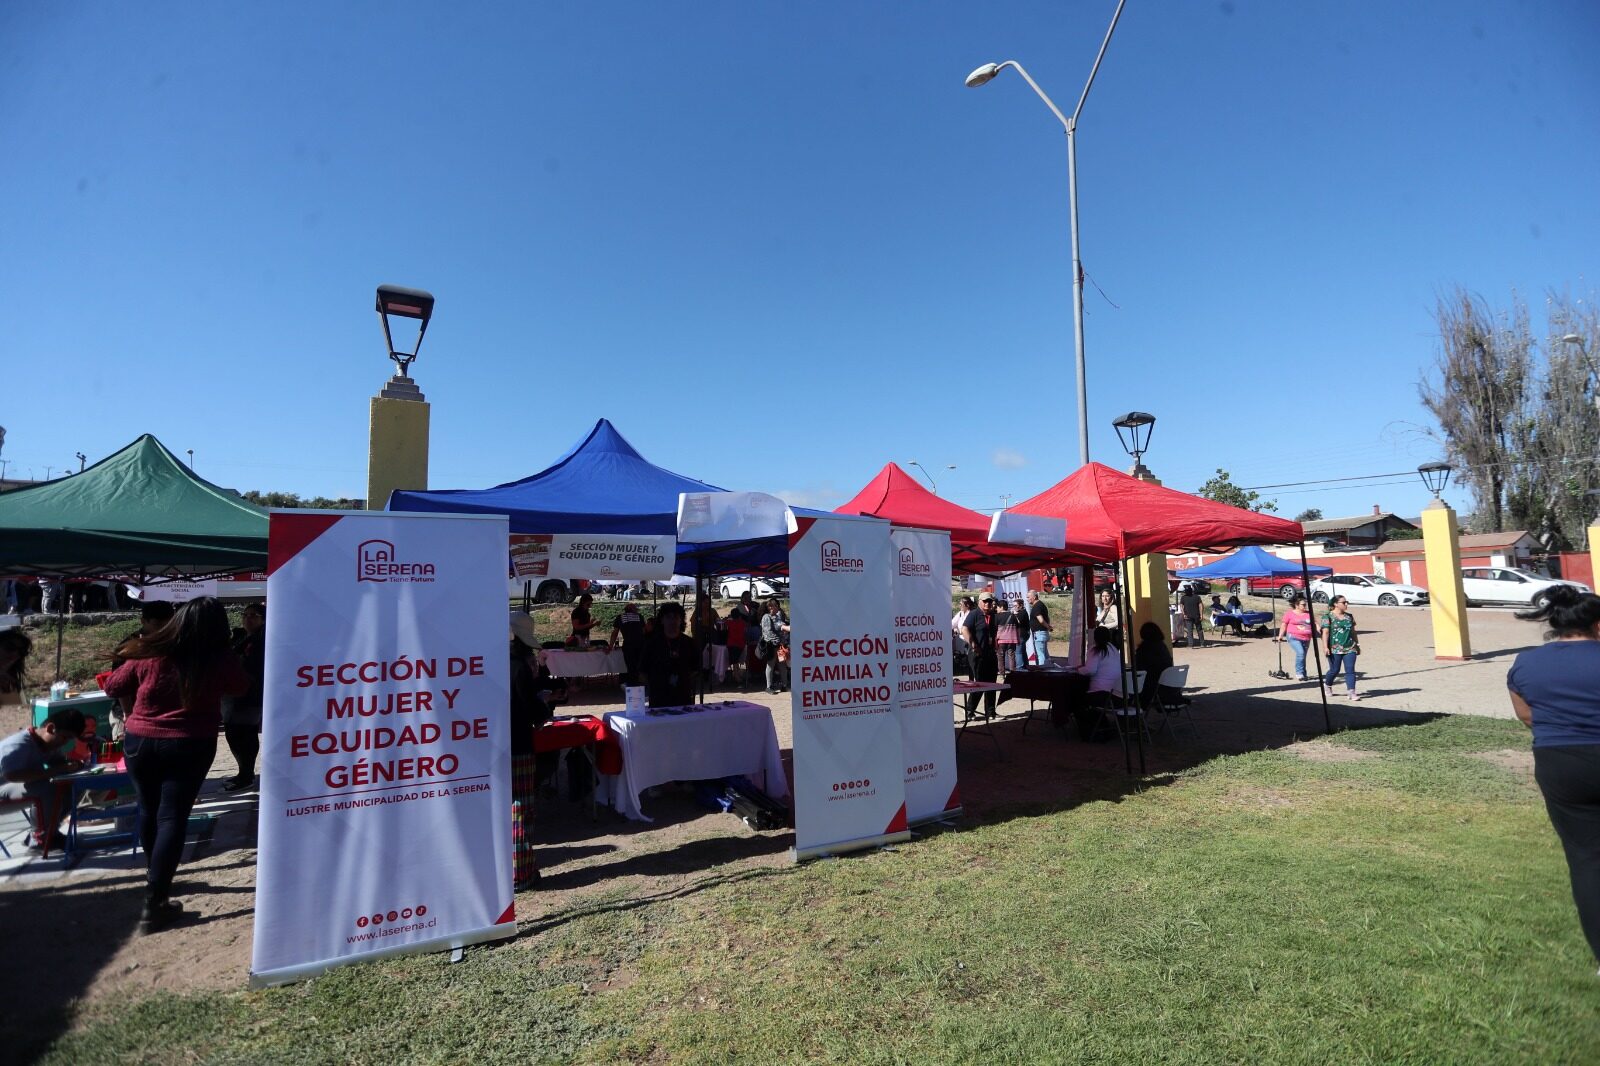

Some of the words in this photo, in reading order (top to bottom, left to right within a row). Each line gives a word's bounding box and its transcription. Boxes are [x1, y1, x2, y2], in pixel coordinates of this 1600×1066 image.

[570, 542, 613, 551] SECCIÓN
[616, 544, 649, 553] MUJER
[651, 545, 658, 553] Y
[825, 549, 837, 557] LA
[365, 551, 388, 562] LA
[559, 551, 607, 560] EQUIDAD
[608, 553, 623, 561] DE
[624, 552, 665, 563] GÉNERO
[825, 559, 863, 567] SERENA
[365, 564, 435, 575] SERENA
[902, 564, 930, 572] SERENA
[894, 613, 935, 627] SECCIÓN
[801, 634, 888, 658] SECCIÓN
[896, 647, 944, 659] IVERSIDAD
[296, 654, 437, 688] SECCIÓN
[447, 656, 485, 677] DE
[801, 663, 873, 683] FAMILIA
[878, 662, 889, 678] Y
[901, 662, 942, 676] PUEBLOS
[898, 677, 947, 693] IGINARIOS
[802, 685, 891, 707] ENTORNO
[326, 690, 433, 720] MUJER
[441, 689, 461, 709] Y
[290, 723, 441, 758] EQUIDAD
[451, 718, 489, 742] DE
[325, 753, 459, 789] GÉNERO
[286, 803, 331, 817] ILUSTRE
[334, 792, 419, 811] MUNICIPALIDAD
[421, 790, 435, 799] DE
[437, 788, 450, 797] LA
[452, 783, 491, 795] SERENA
[828, 788, 876, 801] www.laserena.cl
[346, 917, 437, 944] www.laserena.cl
